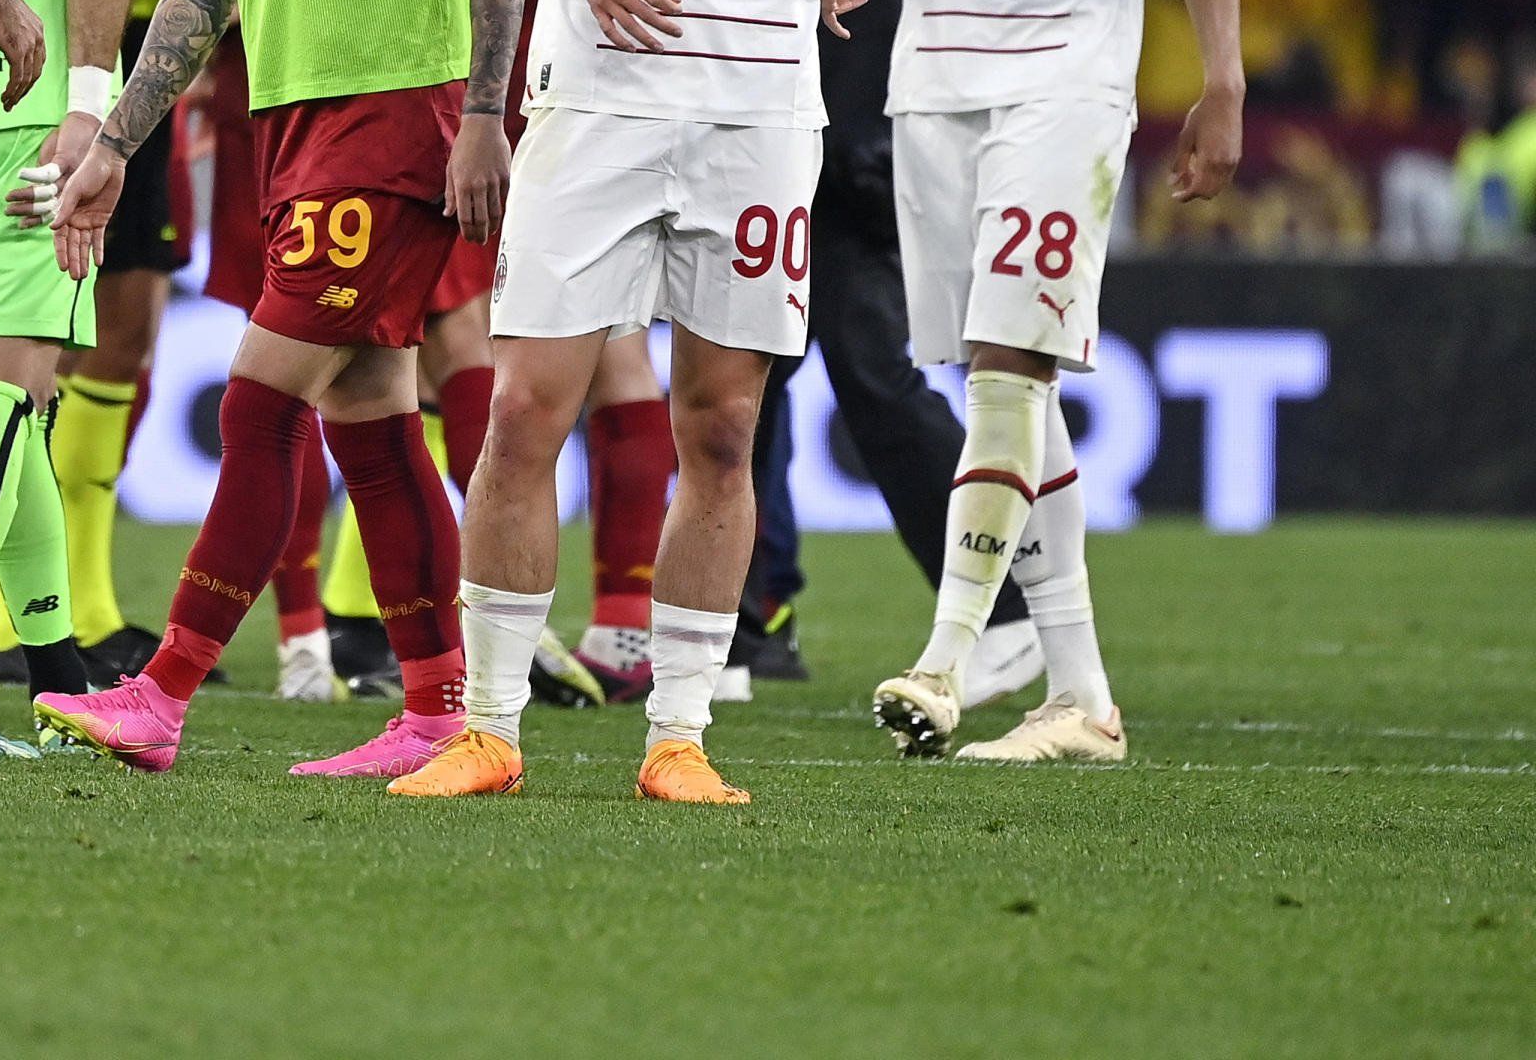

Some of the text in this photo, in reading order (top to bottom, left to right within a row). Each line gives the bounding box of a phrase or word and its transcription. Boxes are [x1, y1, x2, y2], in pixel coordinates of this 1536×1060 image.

[281, 197, 373, 269] 59
[731, 203, 809, 283] 90
[990, 206, 1078, 280] 28
[958, 531, 1008, 557] ACM
